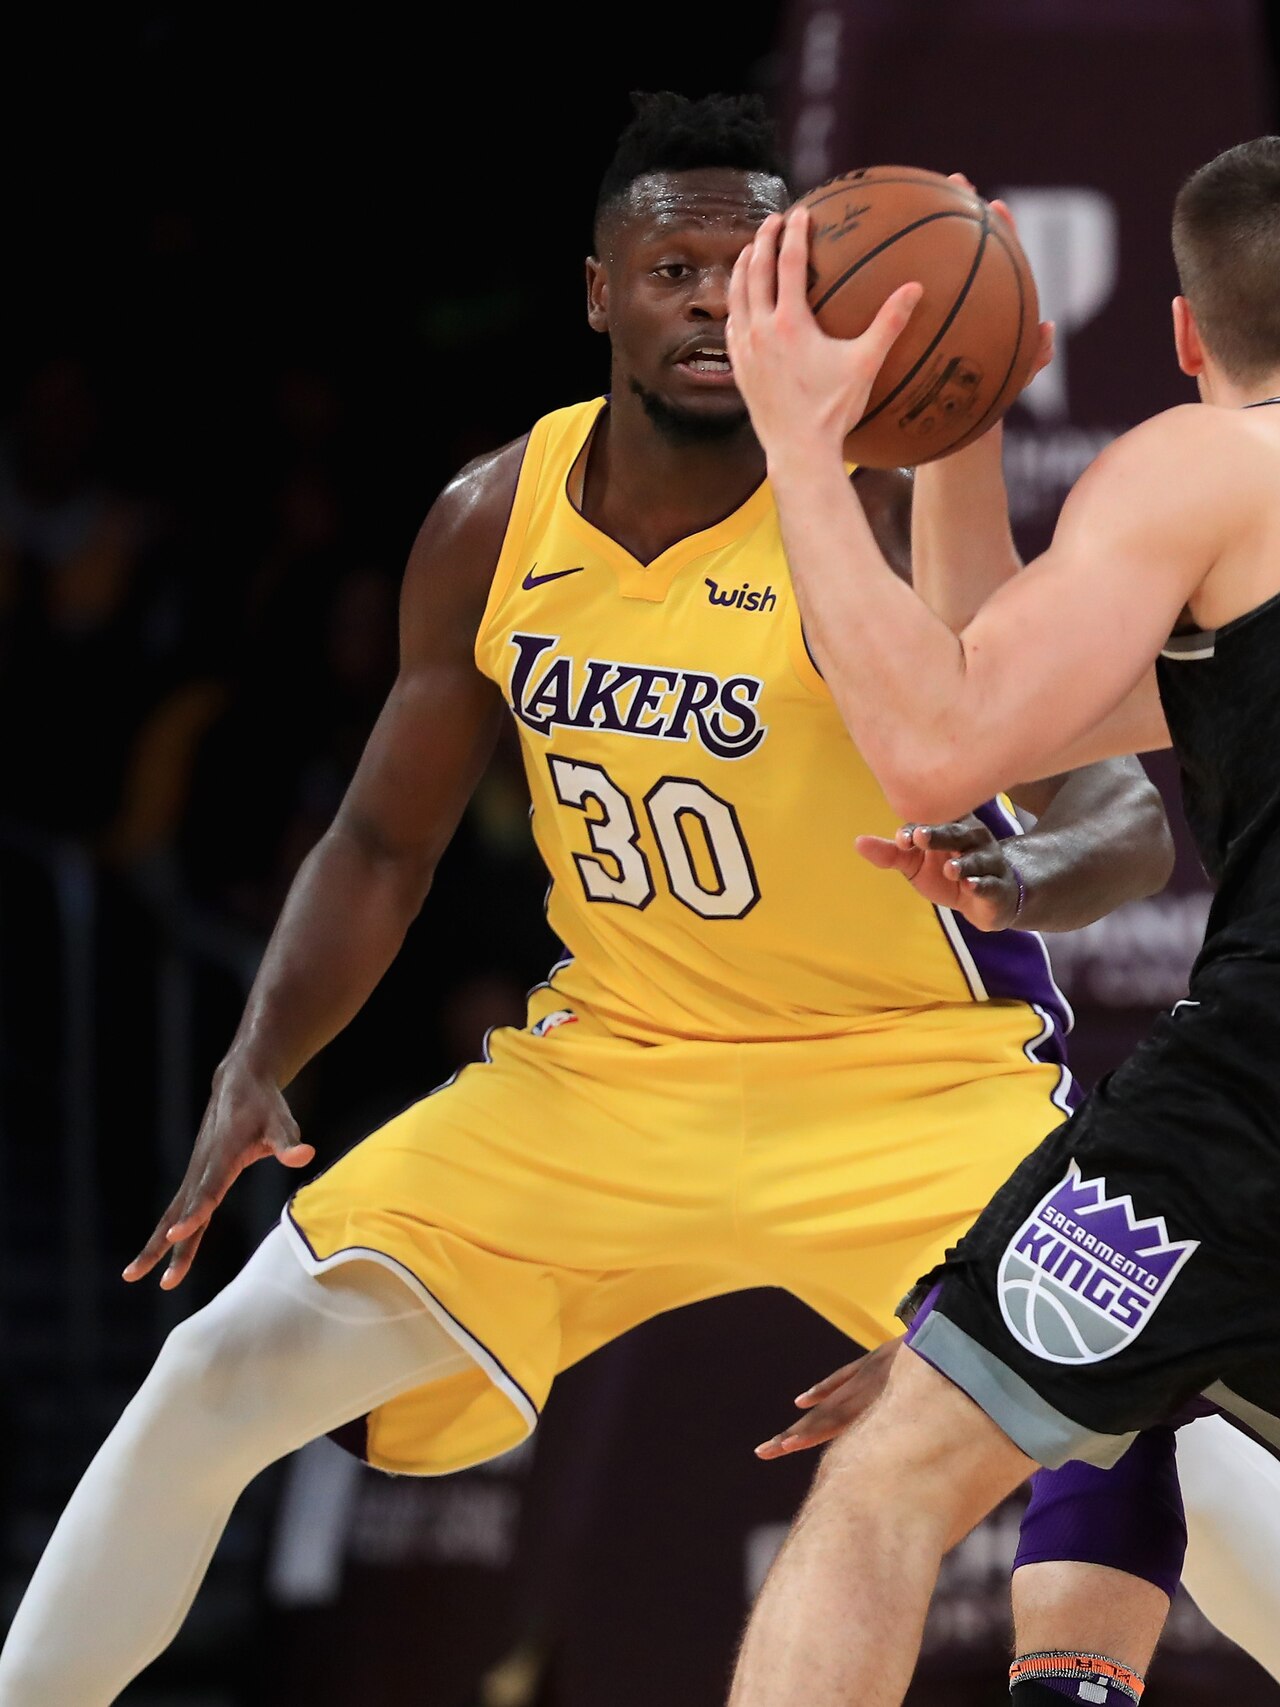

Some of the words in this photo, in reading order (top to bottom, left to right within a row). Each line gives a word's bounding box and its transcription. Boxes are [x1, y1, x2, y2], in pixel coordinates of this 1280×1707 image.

[704, 577, 777, 612] wish
[508, 632, 767, 760] LAKERS
[546, 753, 762, 920] 30
[1015, 1223, 1150, 1329] KINGS
[1042, 1206, 1159, 1290] SACRAMENTO
